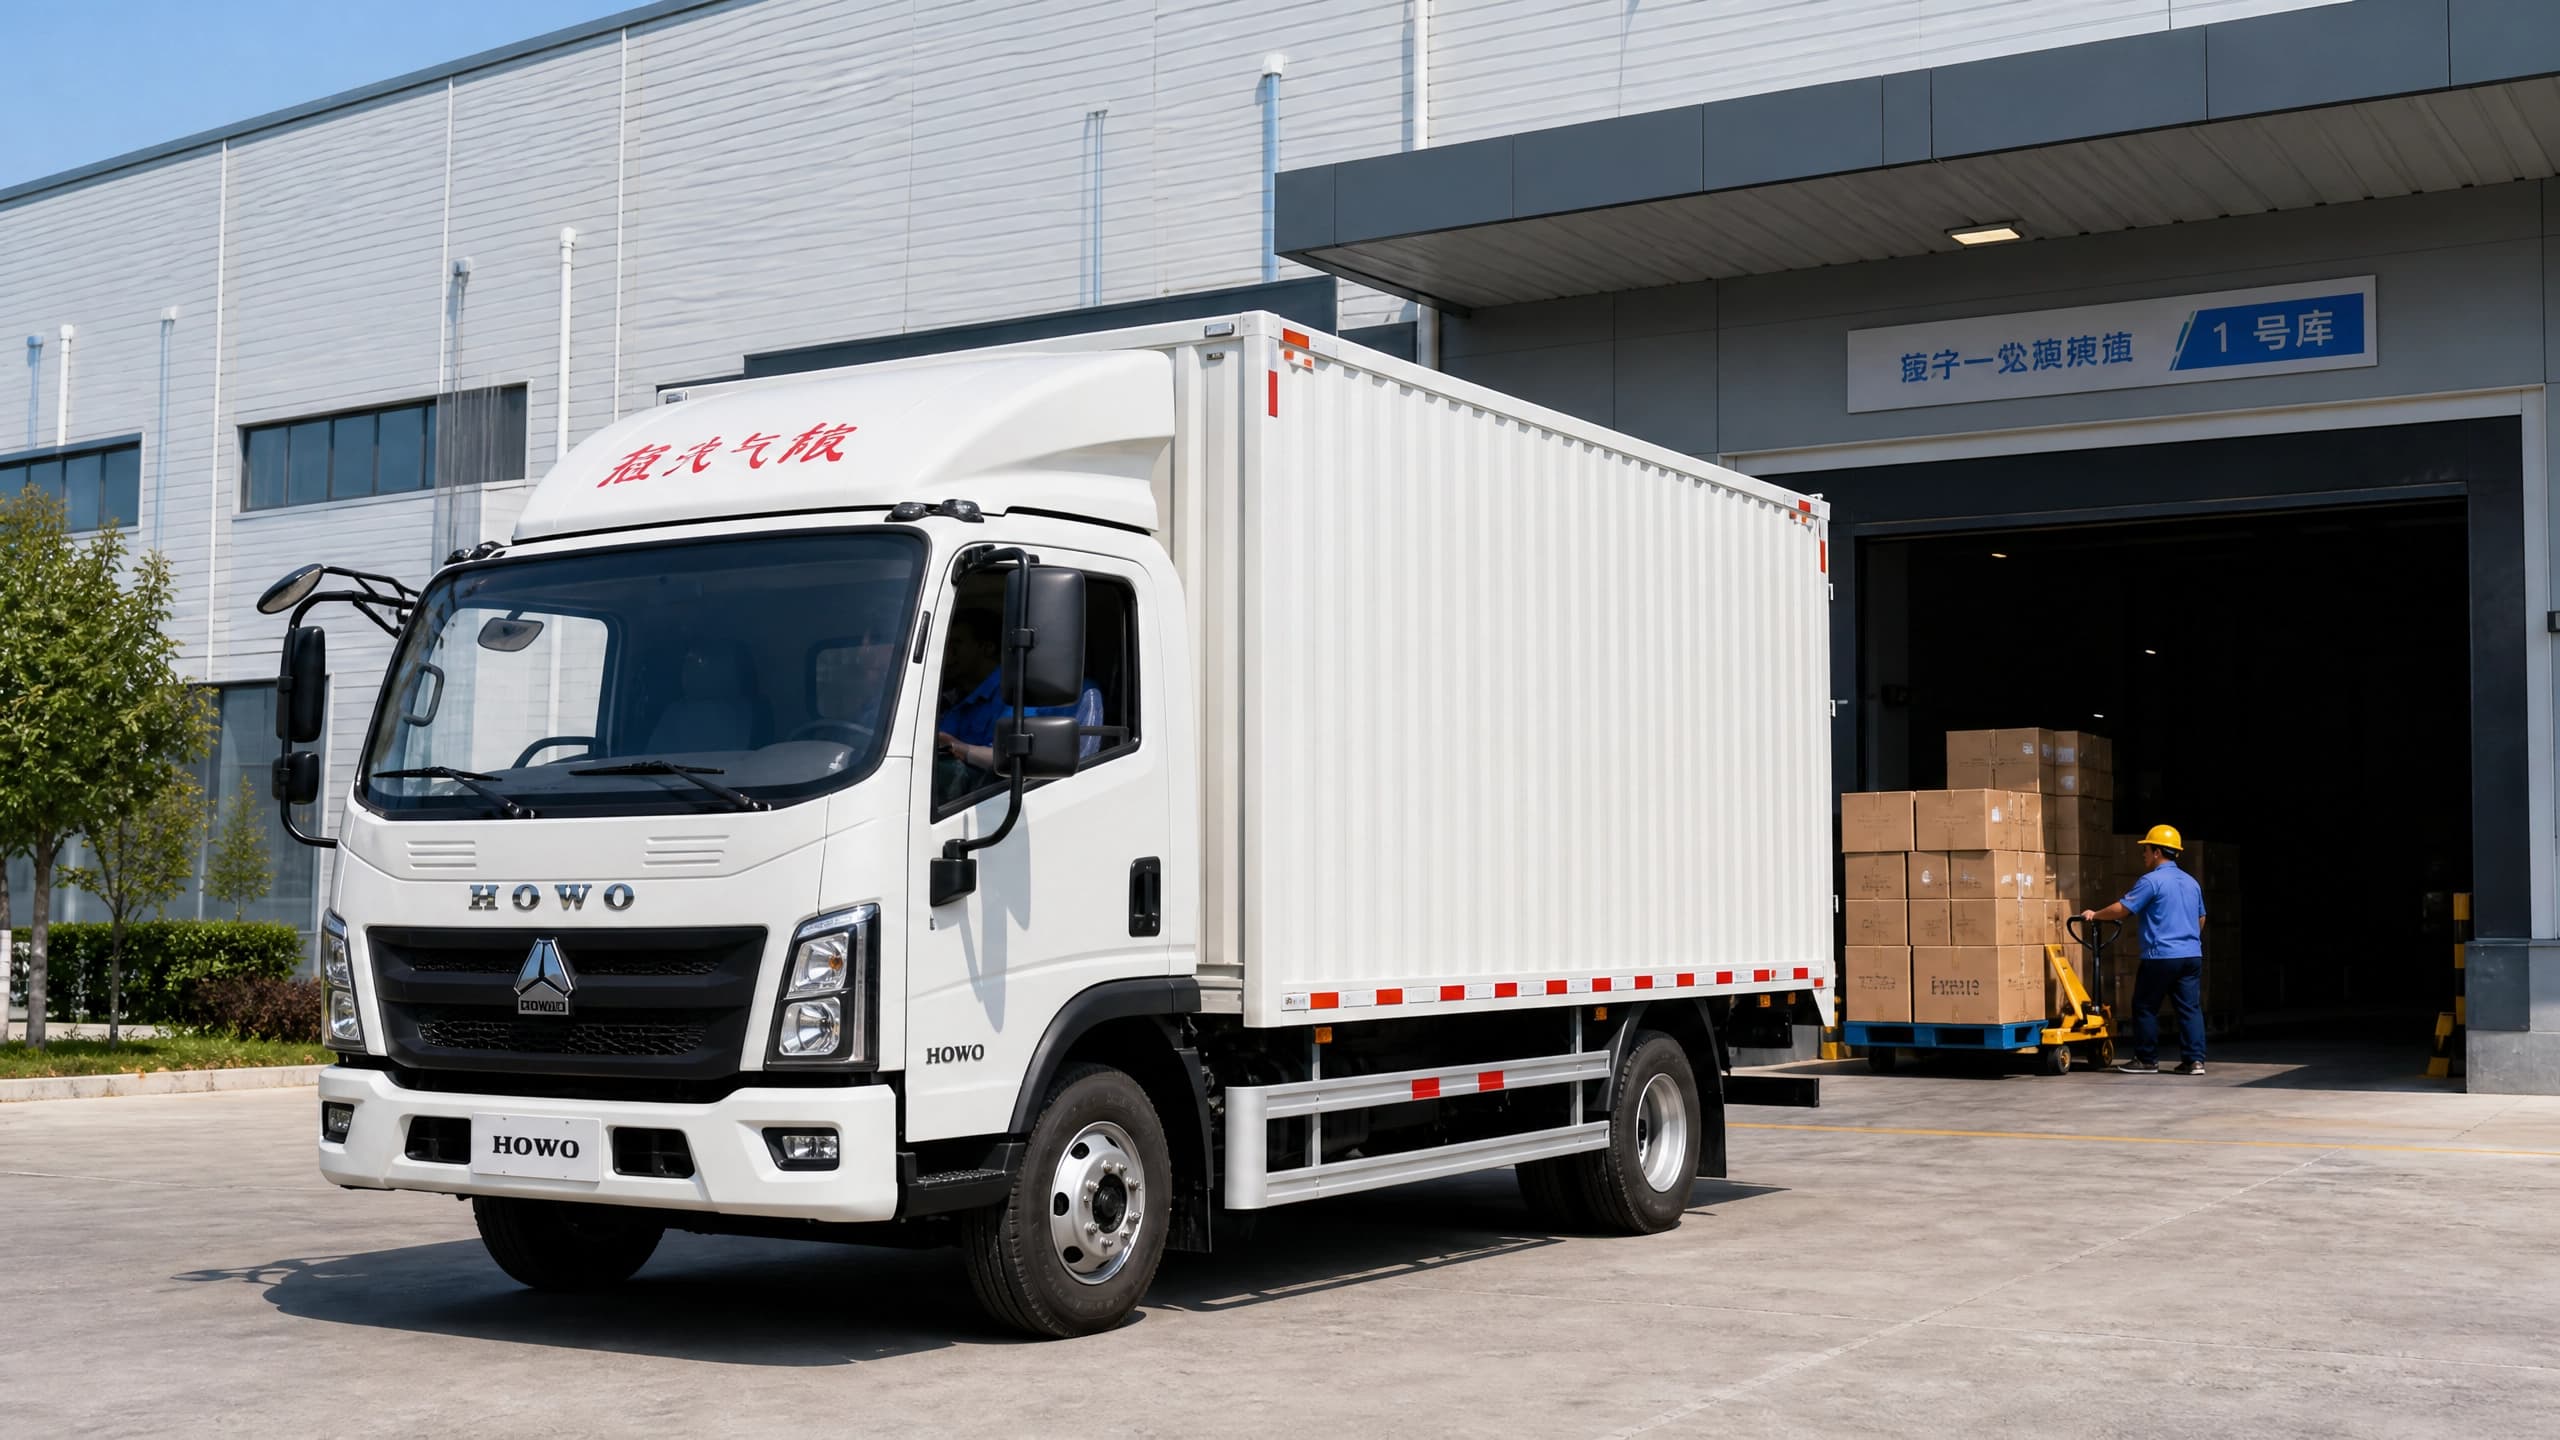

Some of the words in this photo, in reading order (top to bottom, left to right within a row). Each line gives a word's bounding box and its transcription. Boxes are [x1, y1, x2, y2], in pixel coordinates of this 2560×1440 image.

[2213, 321, 2227, 353] 1
[2252, 309, 2335, 351] 号库
[468, 884, 635, 911] HOWO
[926, 1043, 985, 1066] HOWO
[492, 1135, 580, 1159] HOWO
